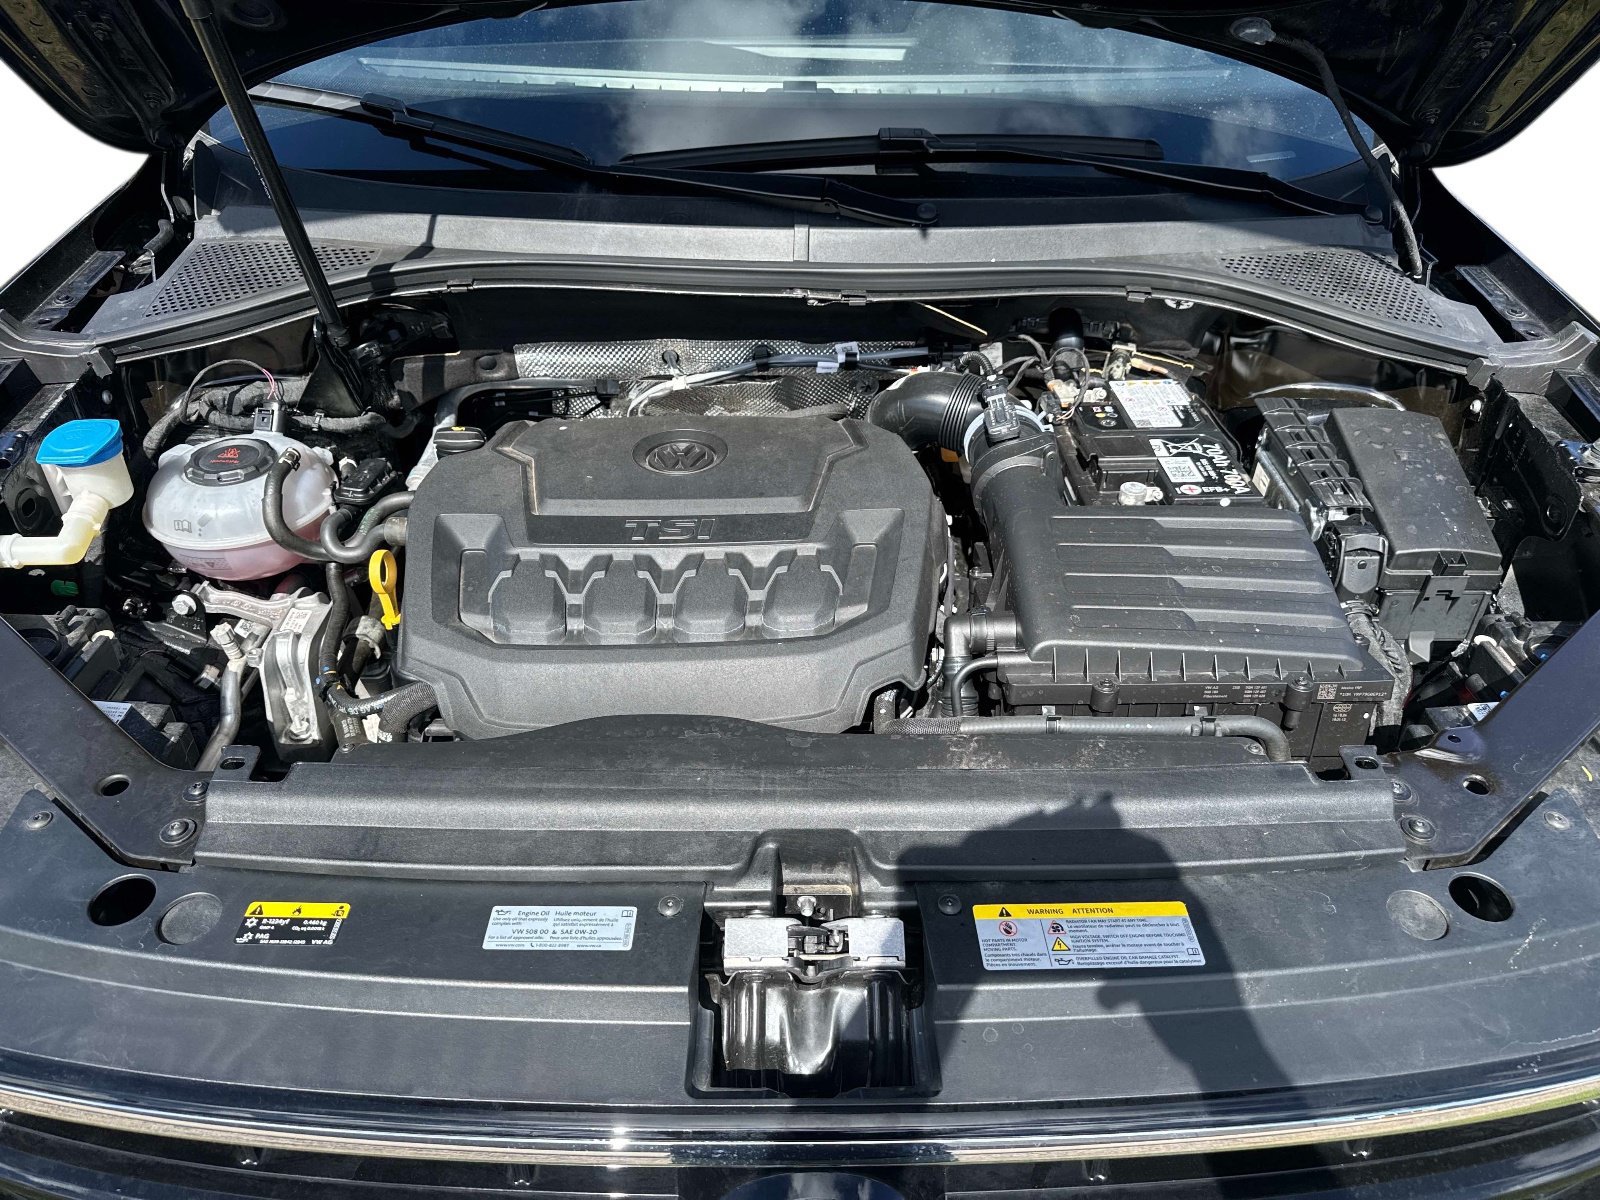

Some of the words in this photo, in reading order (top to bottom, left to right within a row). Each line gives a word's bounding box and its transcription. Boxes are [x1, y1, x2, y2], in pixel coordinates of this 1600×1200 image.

[1203, 444, 1231, 468] 70Ah
[1220, 468, 1250, 494] 700A
[625, 519, 716, 540] TSI
